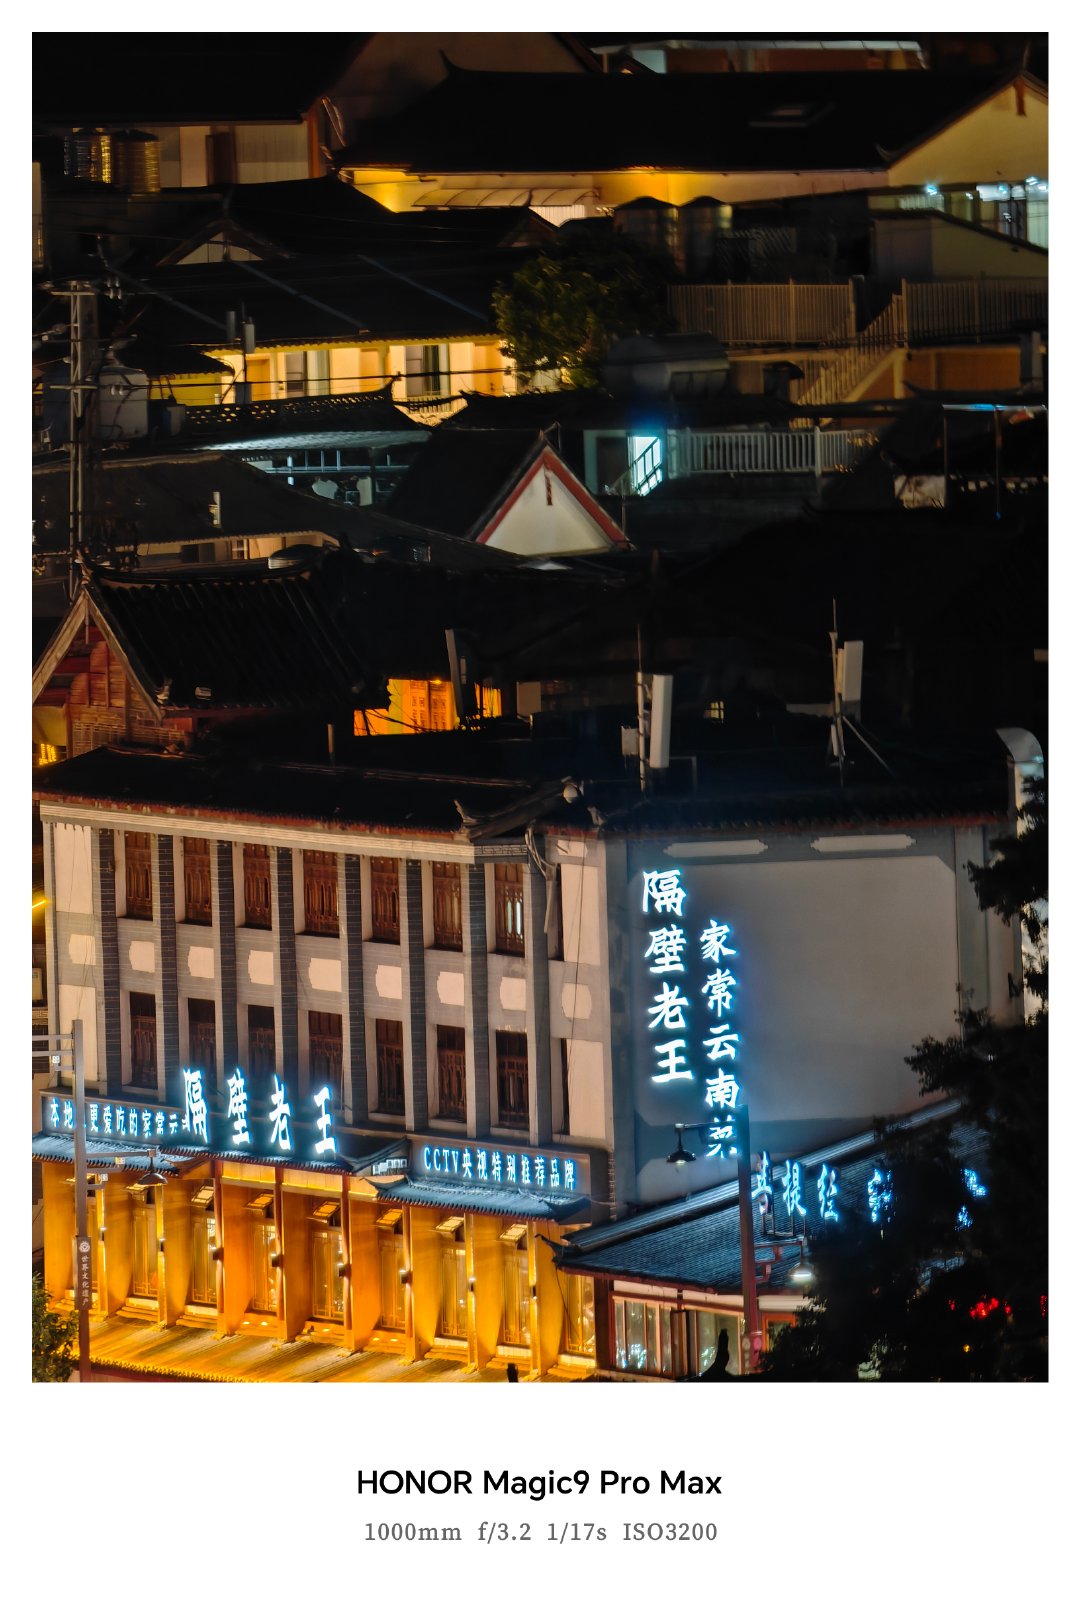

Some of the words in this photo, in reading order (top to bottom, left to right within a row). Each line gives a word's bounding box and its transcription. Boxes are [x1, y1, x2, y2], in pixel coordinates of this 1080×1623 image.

[642, 869, 694, 1084] 隔壁老王
[183, 1068, 337, 1154] 隔壁老王
[423, 1146, 575, 1190] CCTV央视特别推荐品牌
[81, 1255, 89, 1306] 世界文化遗产
